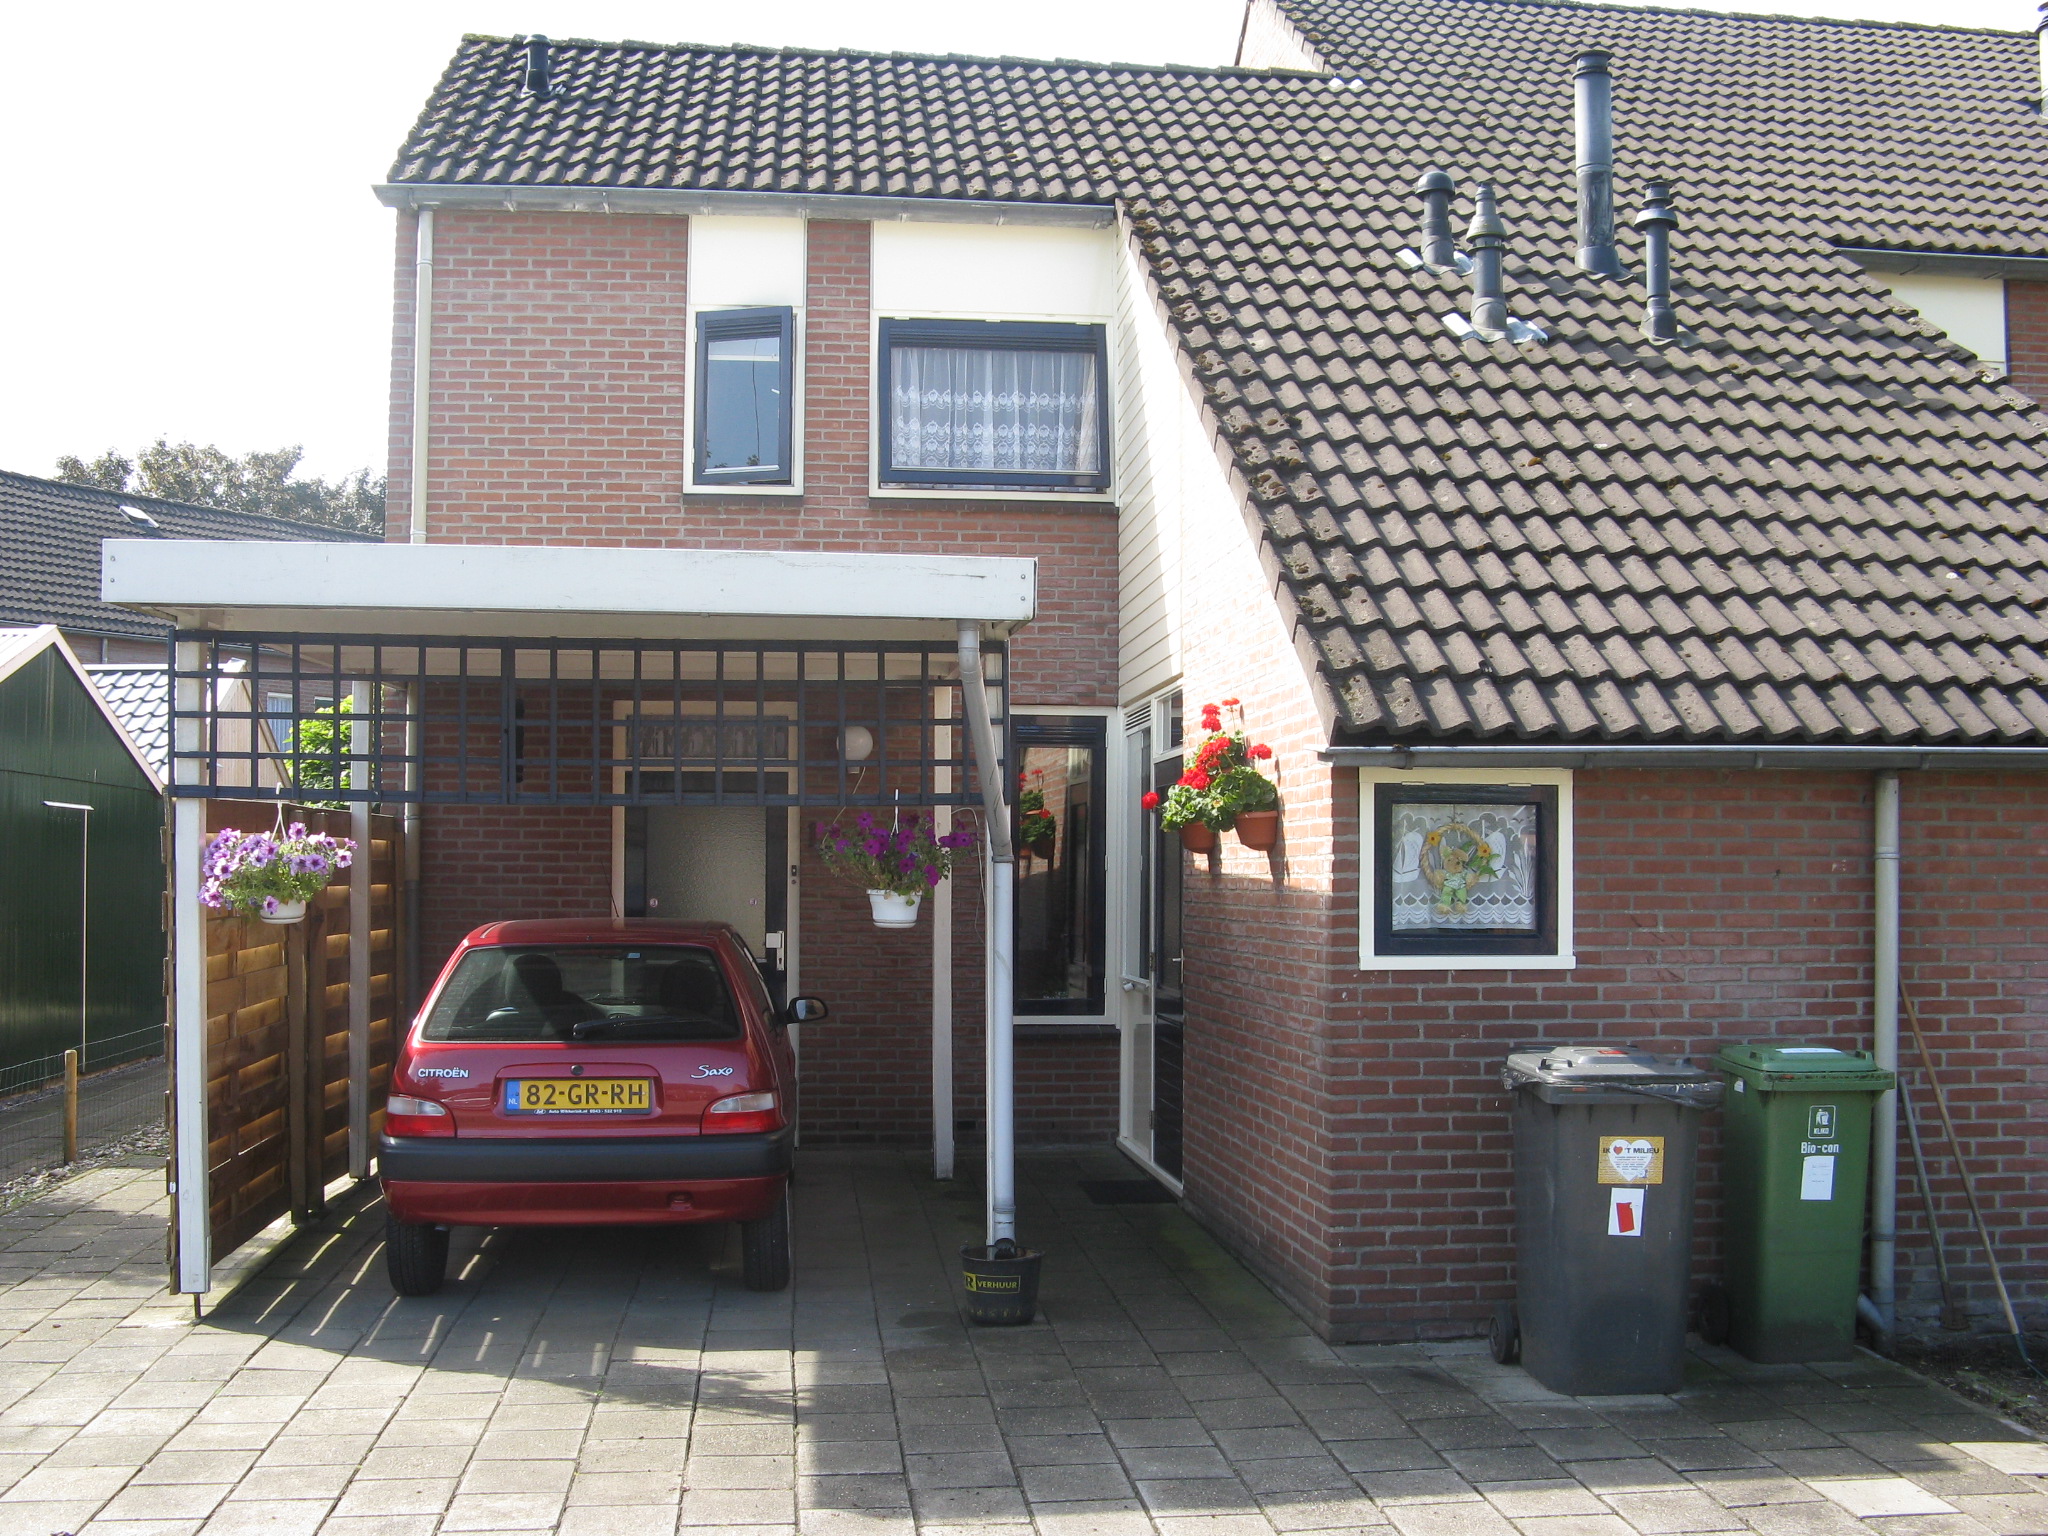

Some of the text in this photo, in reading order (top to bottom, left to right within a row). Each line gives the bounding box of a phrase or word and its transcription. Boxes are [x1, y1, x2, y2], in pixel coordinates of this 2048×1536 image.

[418, 1067, 469, 1078] CITROËN
[690, 1064, 734, 1079] Saxo
[526, 1083, 644, 1106] 82-GR-RH
[977, 1281, 1018, 1289] VERHUUR
